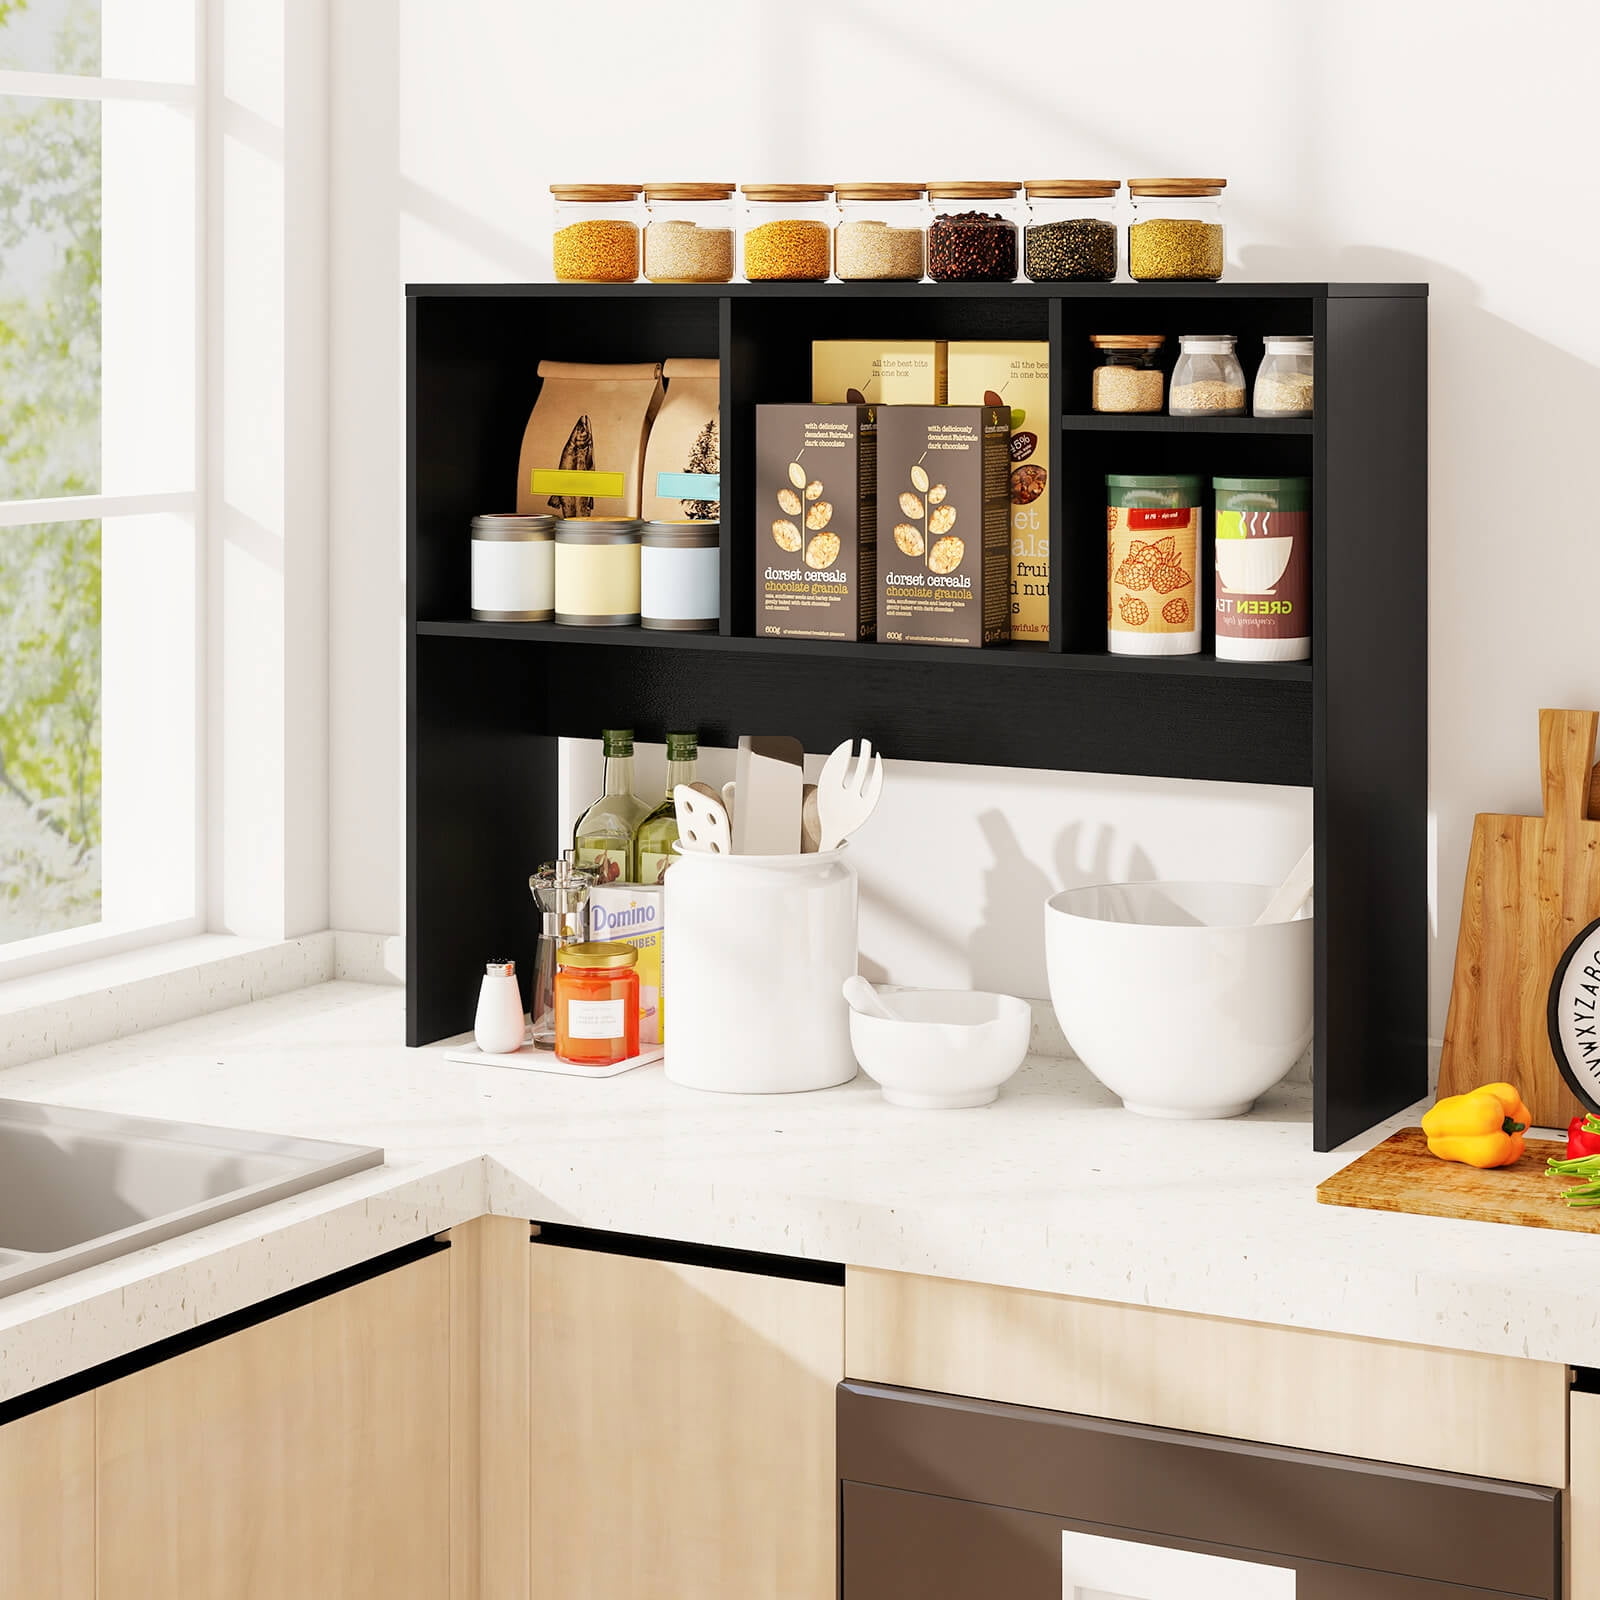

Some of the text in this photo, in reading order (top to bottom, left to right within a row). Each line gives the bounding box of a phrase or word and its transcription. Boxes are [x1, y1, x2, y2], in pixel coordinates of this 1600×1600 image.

[818, 423, 848, 431] deliciously
[942, 425, 972, 433] deliciously
[764, 567, 847, 583] dorset cereals
[1016, 561, 1049, 578] frui
[886, 572, 971, 588] dorset cereals
[764, 581, 848, 594] chocolate granola
[886, 586, 973, 600] chocolate granola
[765, 625, 781, 635] 600g
[1041, 623, 1049, 632] 70
[886, 631, 903, 641] 600g
[591, 903, 656, 931] Domino
